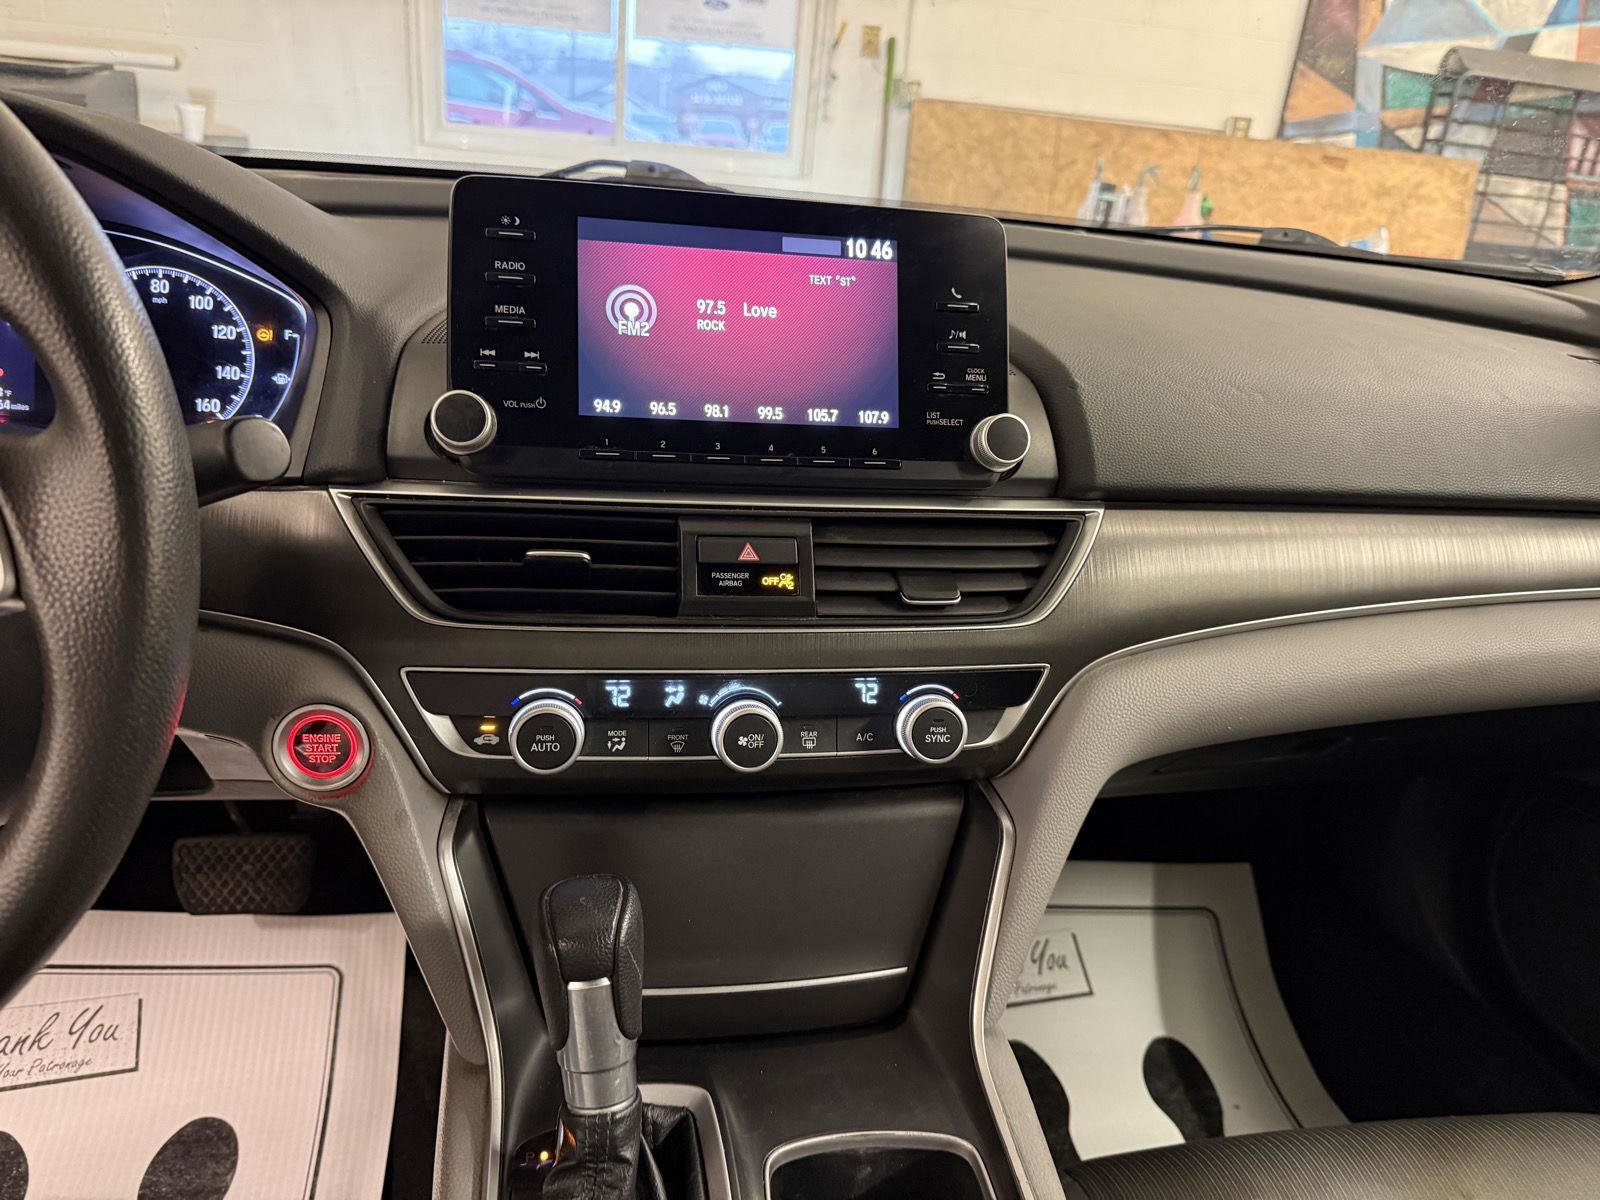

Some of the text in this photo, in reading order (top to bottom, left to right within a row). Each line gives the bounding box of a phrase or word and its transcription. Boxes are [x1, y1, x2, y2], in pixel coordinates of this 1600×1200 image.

[494, 260, 526, 271] RADIO
[808, 274, 832, 286] TEXT
[150, 279, 170, 294] 80
[152, 296, 168, 305] mph
[188, 296, 213, 310] 100
[494, 304, 526, 315] MEDIA
[696, 299, 778, 319] 97.5 Love
[617, 320, 650, 336] FM2
[696, 319, 726, 332] ROCK
[211, 325, 236, 340] 120
[284, 330, 293, 340] F
[215, 365, 240, 380] 140
[965, 374, 987, 382] MENU
[195, 398, 221, 412] 160
[503, 399, 536, 409] VOL PUSH
[593, 398, 889, 424] 94.9 96.5 98.1 99.5 105.7 107.9
[926, 411, 941, 419] LIST
[939, 418, 964, 427] SELECT
[660, 440, 666, 448] 2
[715, 442, 721, 450] 3
[768, 444, 774, 452] 4
[821, 446, 826, 454] 5
[761, 576, 780, 586] OFF
[604, 684, 632, 708] 72
[854, 683, 880, 705] 72
[302, 733, 341, 743] ENGINE
[535, 734, 555, 742] PUSH
[748, 733, 764, 742] ON/
[855, 733, 874, 742] A/C
[925, 734, 951, 743] SYNC
[305, 743, 338, 752] START
[530, 742, 560, 752] AUTO
[748, 741, 764, 749] OFF
[308, 755, 337, 763] STOP
[1030, 938, 1069, 976] You
[68, 1004, 119, 1050] You
[27, 1057, 93, 1076] Patronage
